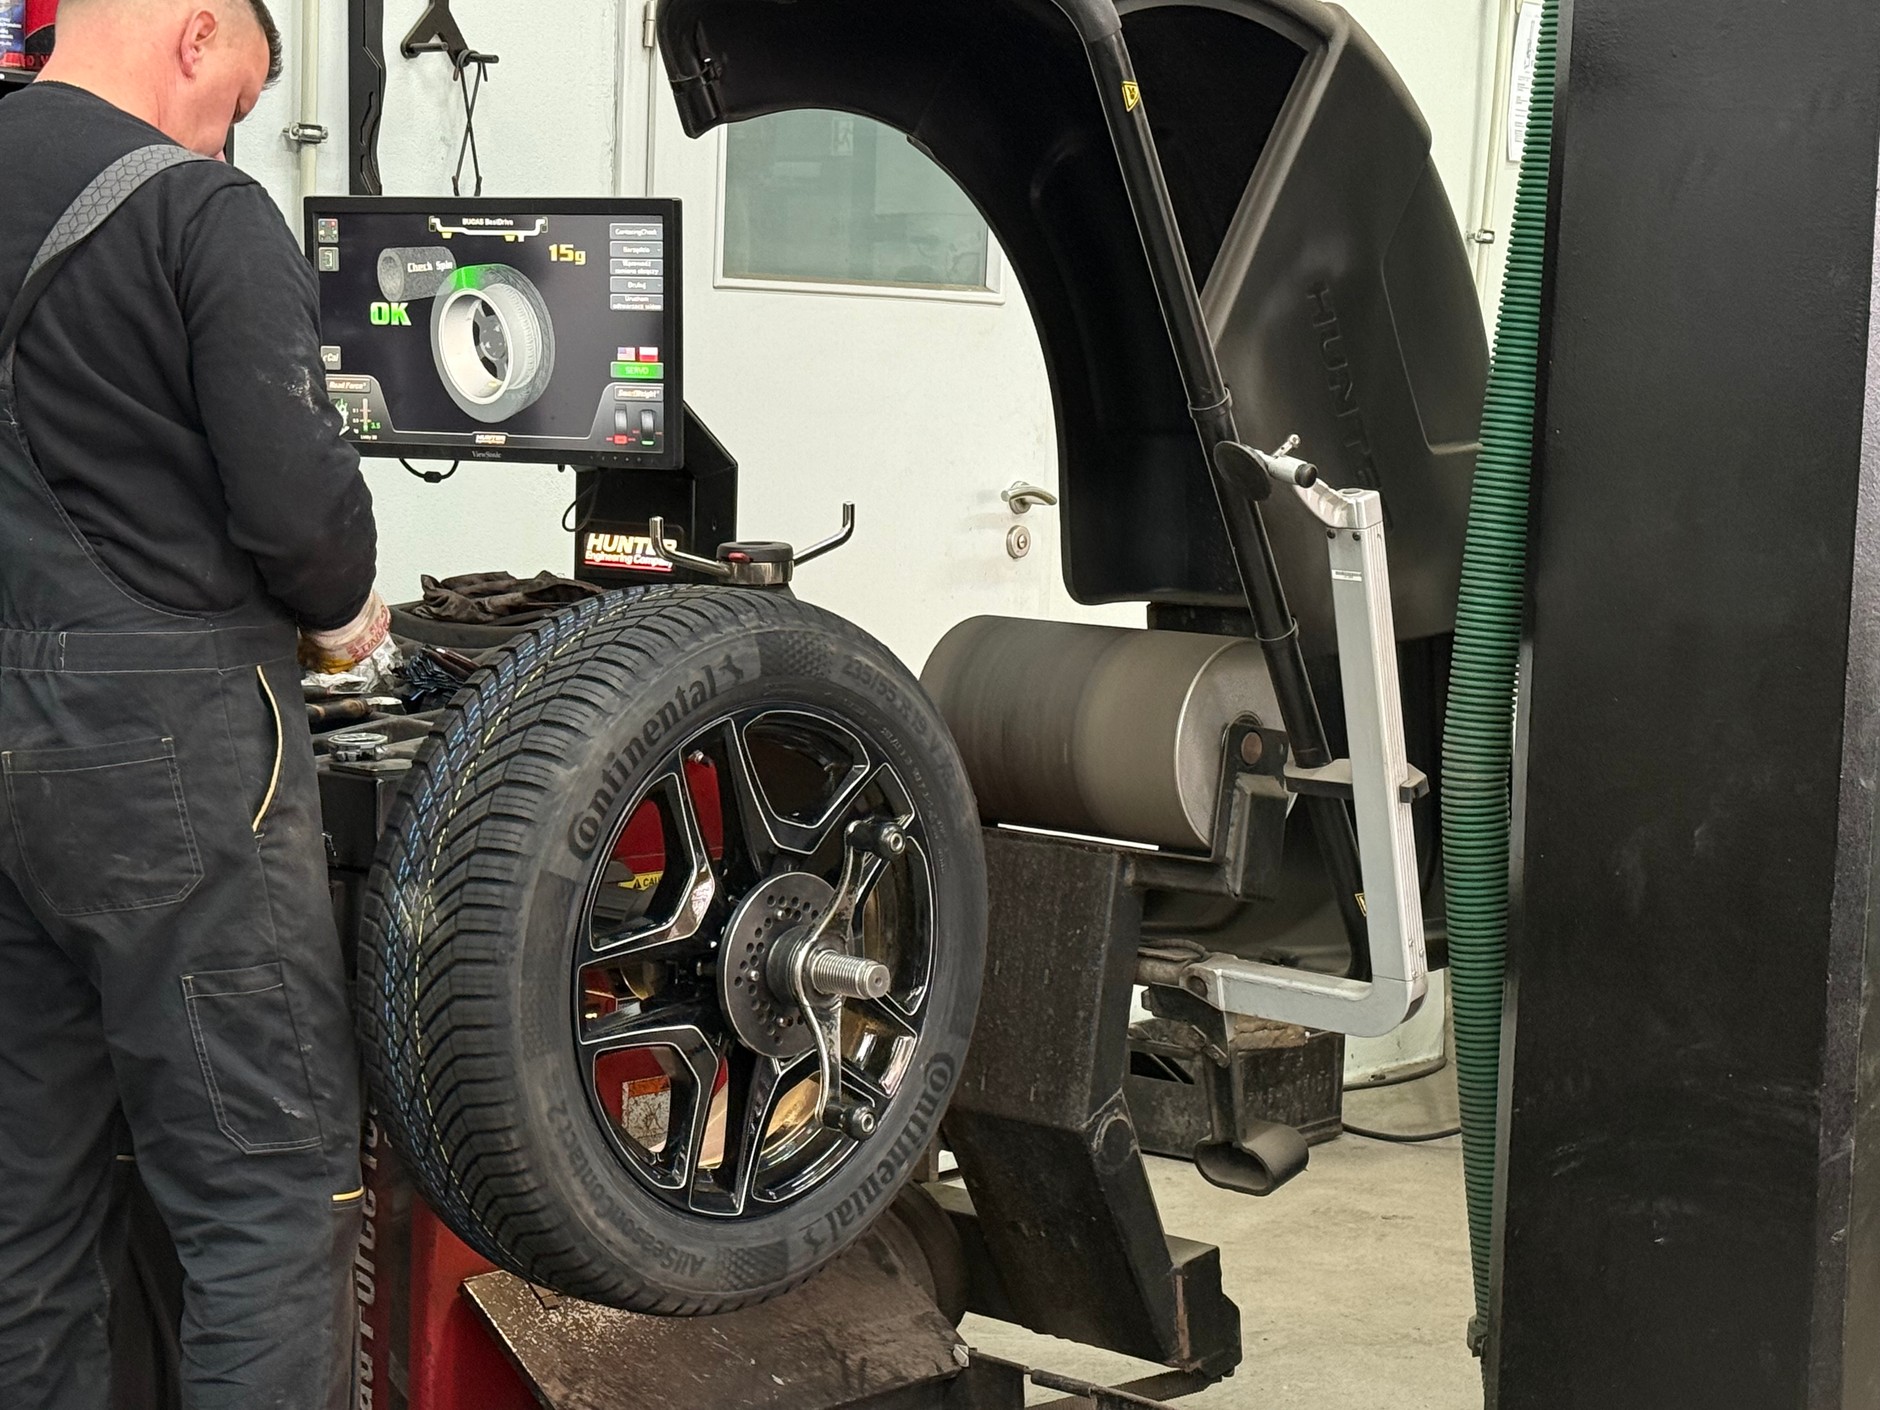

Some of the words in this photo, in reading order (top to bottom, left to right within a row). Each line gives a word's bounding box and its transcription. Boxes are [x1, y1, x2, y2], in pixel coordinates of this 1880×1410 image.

[407, 261, 433, 273] Check
[435, 260, 453, 272] Spin
[548, 243, 587, 265] 15g
[370, 301, 412, 326] OK
[625, 366, 649, 375] SERVO
[1307, 284, 1379, 488] HUNT
[568, 665, 720, 862] Continental
[825, 1053, 955, 1240] Continental
